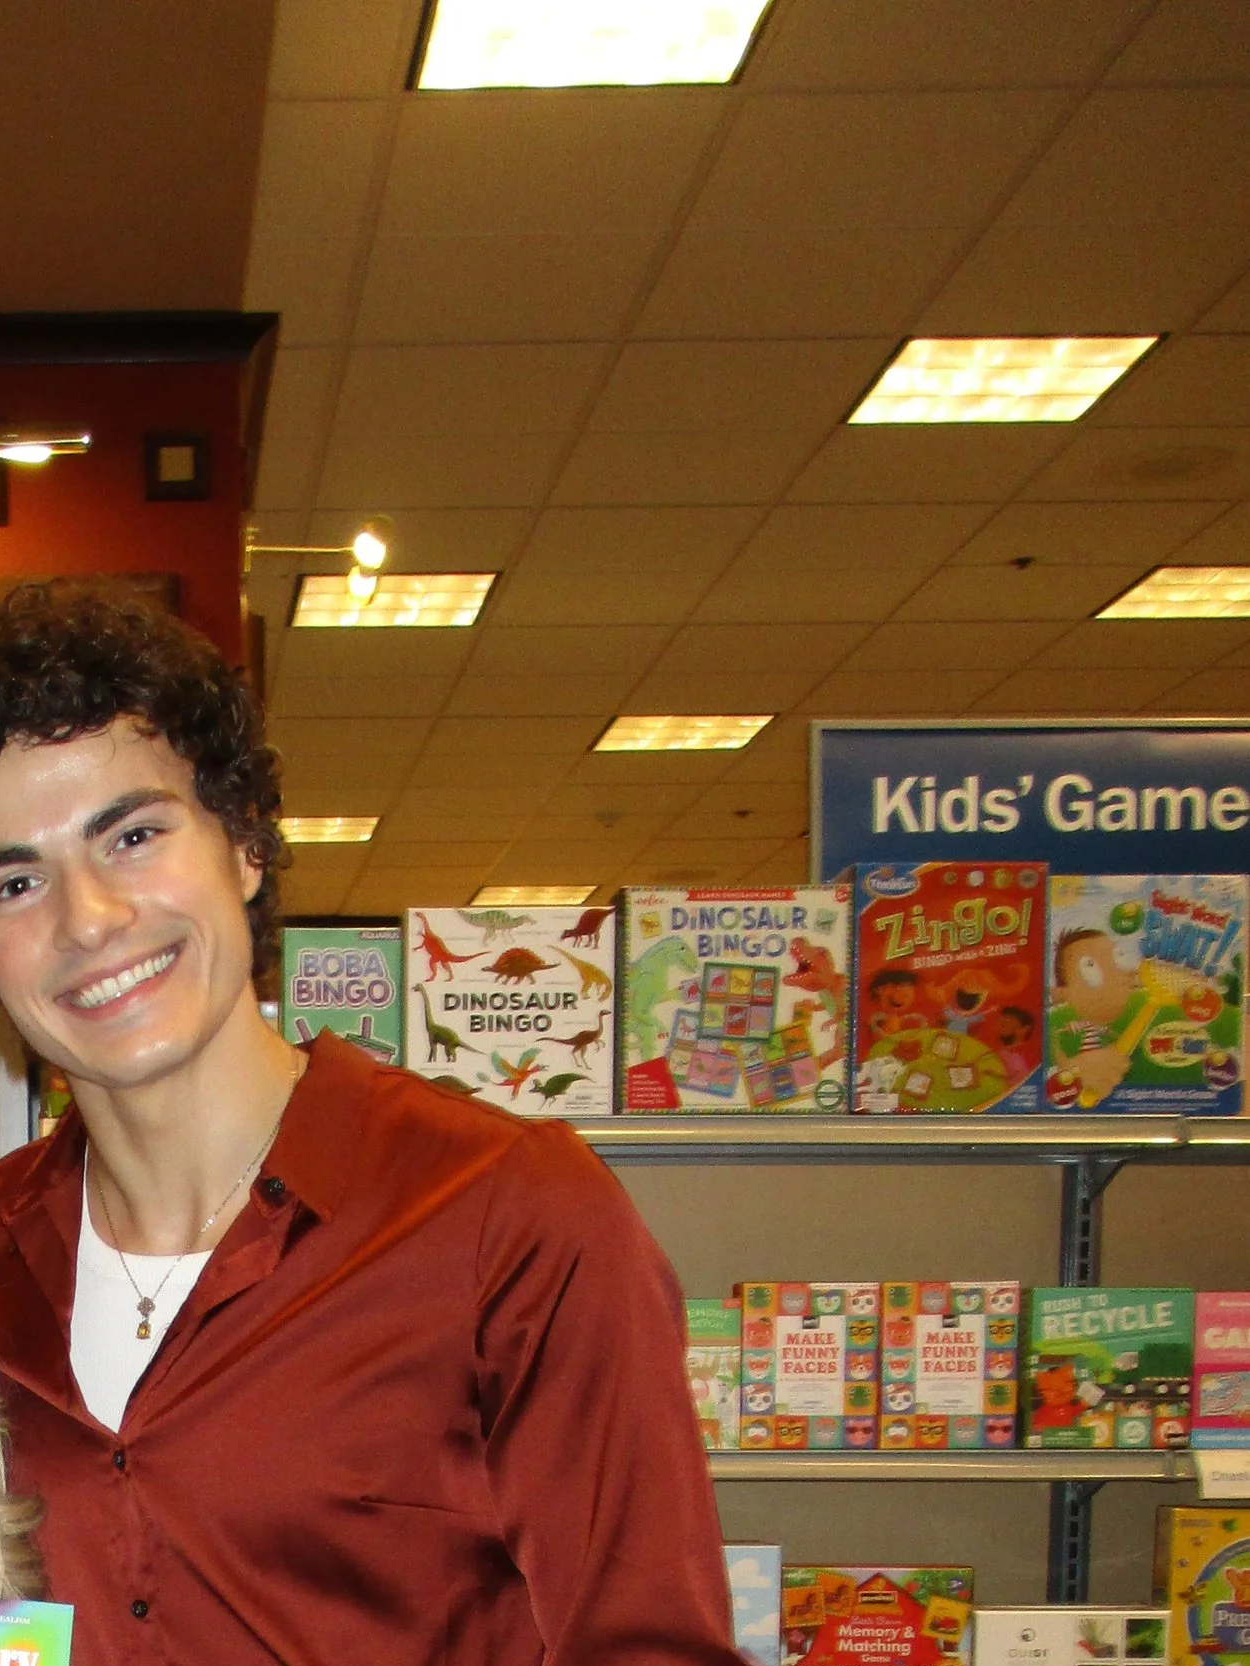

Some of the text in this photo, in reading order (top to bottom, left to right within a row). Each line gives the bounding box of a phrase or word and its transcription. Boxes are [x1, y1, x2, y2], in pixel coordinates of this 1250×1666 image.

[670, 905, 808, 931] DINOSAUR
[876, 898, 1033, 960] Zingo!
[697, 933, 787, 958] BINGO
[300, 951, 385, 978] BOBA
[295, 978, 392, 1005] BINGO
[444, 992, 579, 1011] DINOSAUR
[469, 1013, 553, 1033] BINGO
[1043, 1300, 1175, 1340] RECYCLE
[786, 1333, 836, 1345] MAKE
[926, 1331, 976, 1344] MAKE
[782, 1347, 840, 1360] FUNNY
[922, 1346, 980, 1359] FUNNY
[783, 1361, 837, 1374] FACES
[923, 1360, 977, 1373] FACES
[838, 1624, 915, 1642] Memory &
[838, 1639, 911, 1656] Matching
[862, 1654, 891, 1663] Game
